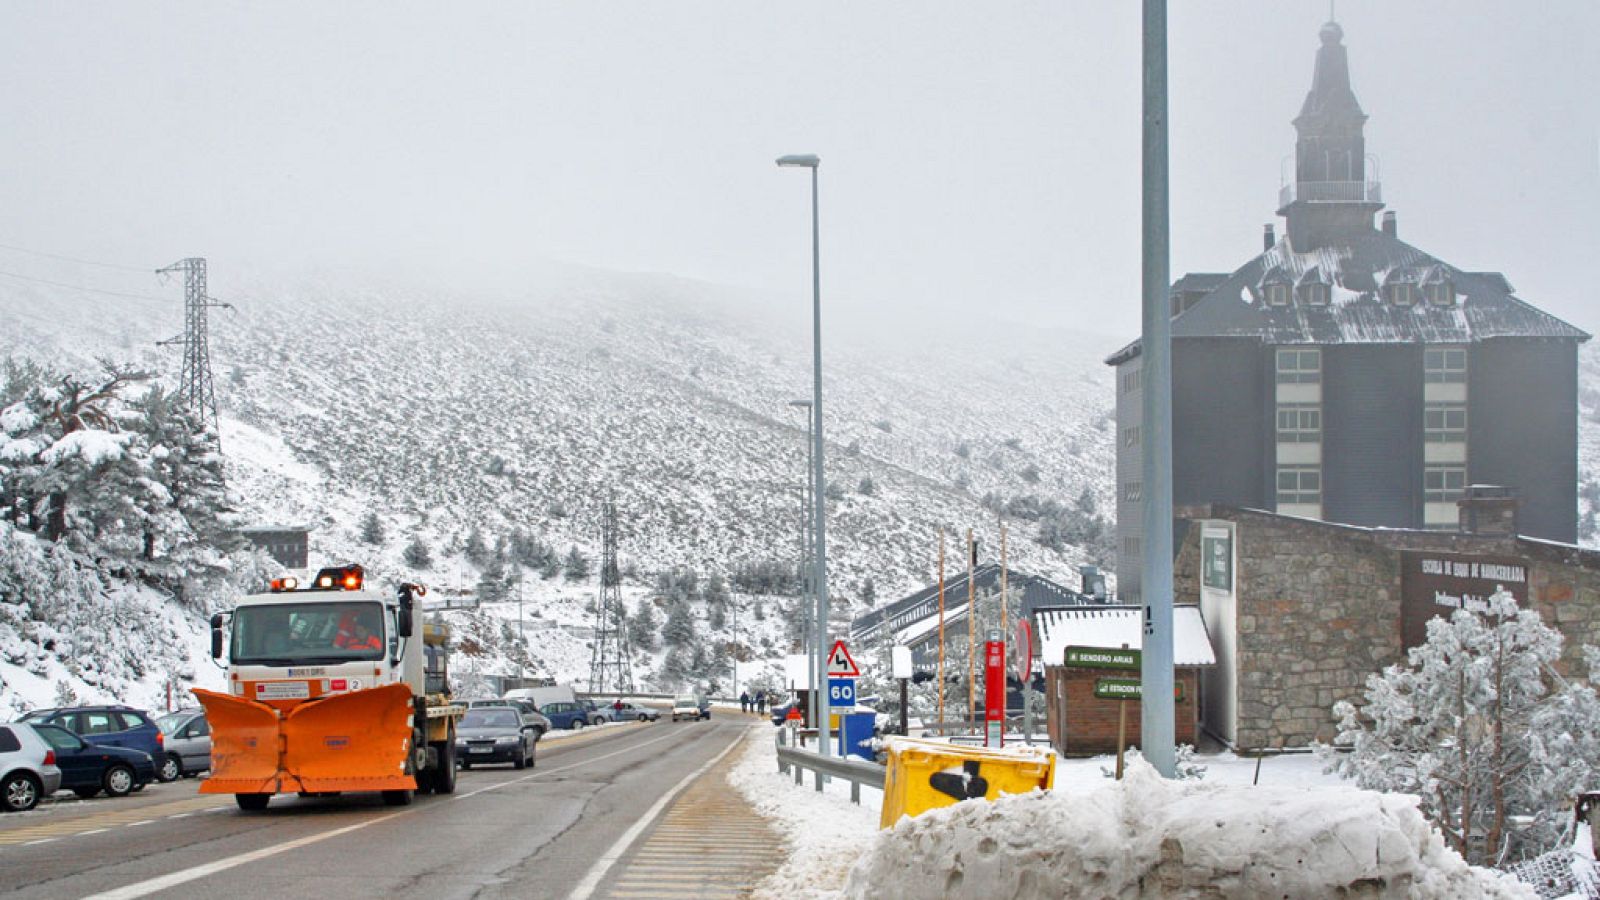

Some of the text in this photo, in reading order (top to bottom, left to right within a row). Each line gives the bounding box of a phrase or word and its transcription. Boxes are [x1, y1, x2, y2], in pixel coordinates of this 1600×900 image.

[1080, 653, 1134, 665] SENDERO ARIAS
[831, 686, 852, 700] 60
